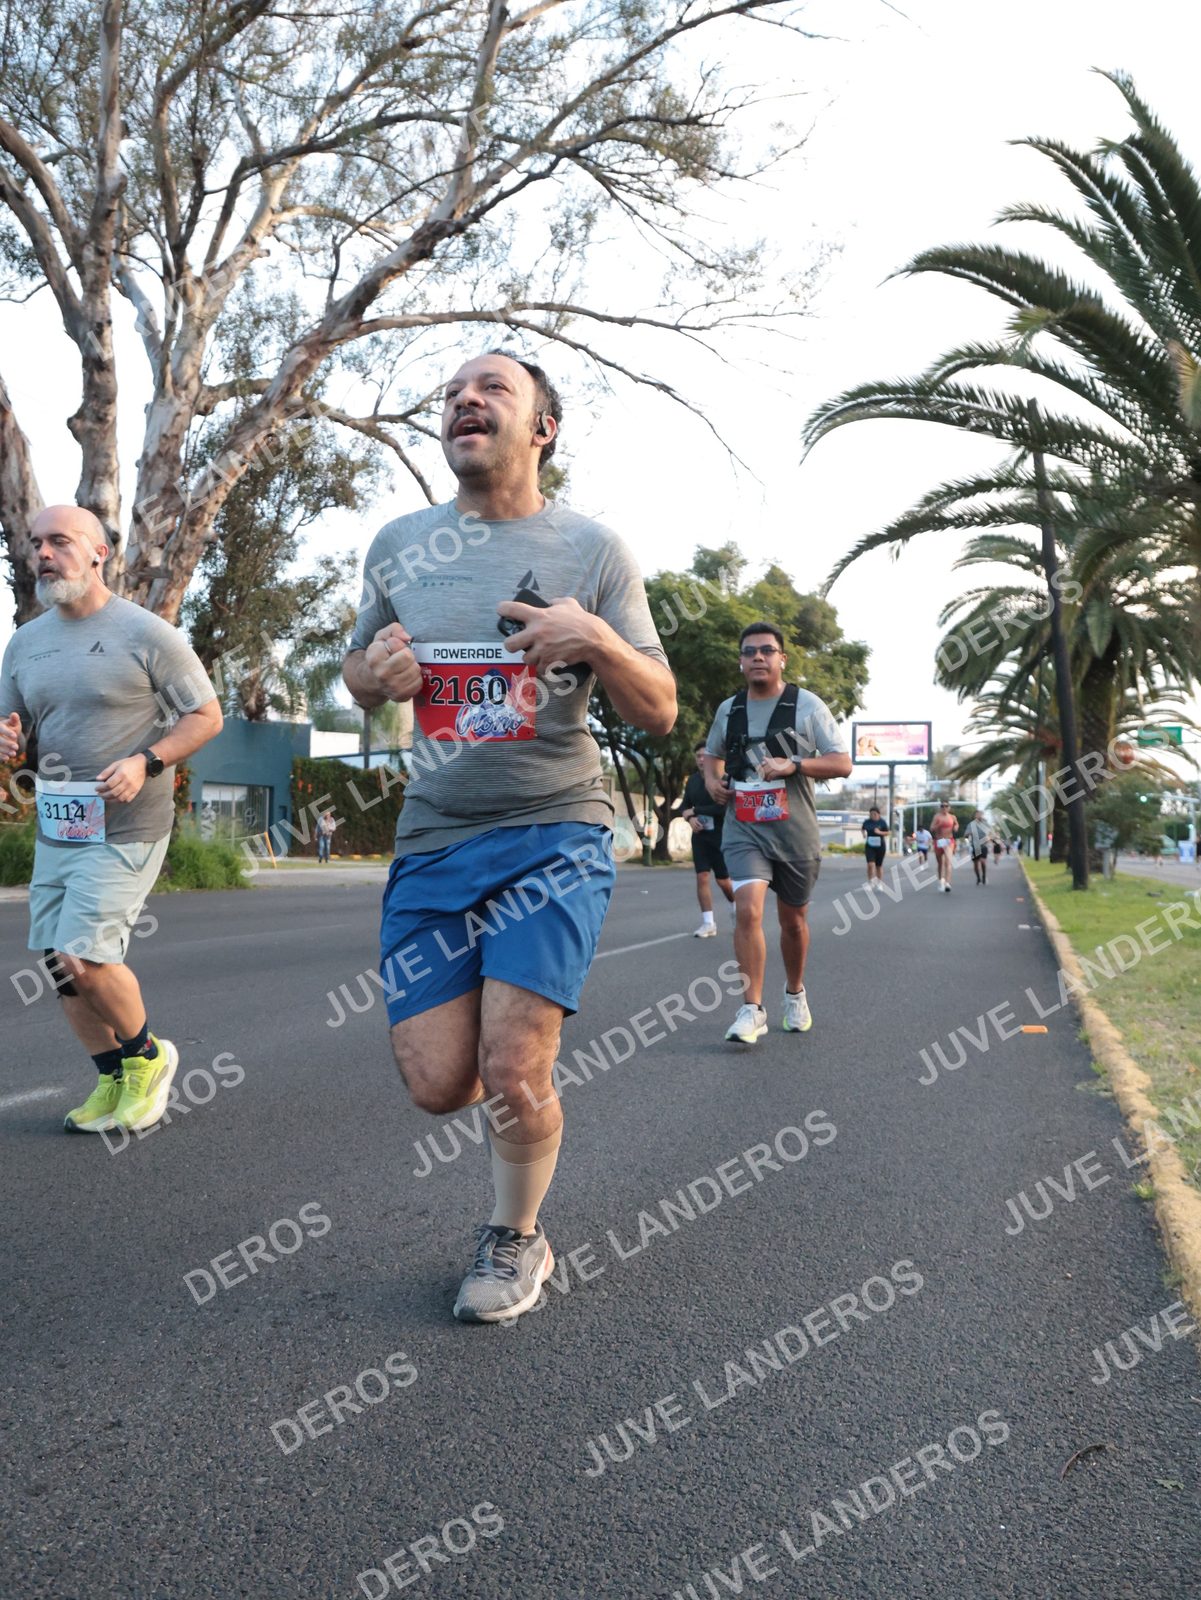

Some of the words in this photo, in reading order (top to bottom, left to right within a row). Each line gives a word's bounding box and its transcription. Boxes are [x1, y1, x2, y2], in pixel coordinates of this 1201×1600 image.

[433, 648, 503, 659] POWERADE
[428, 675, 508, 706] 2160
[743, 793, 776, 808] 2176
[44, 801, 86, 821] 3114
